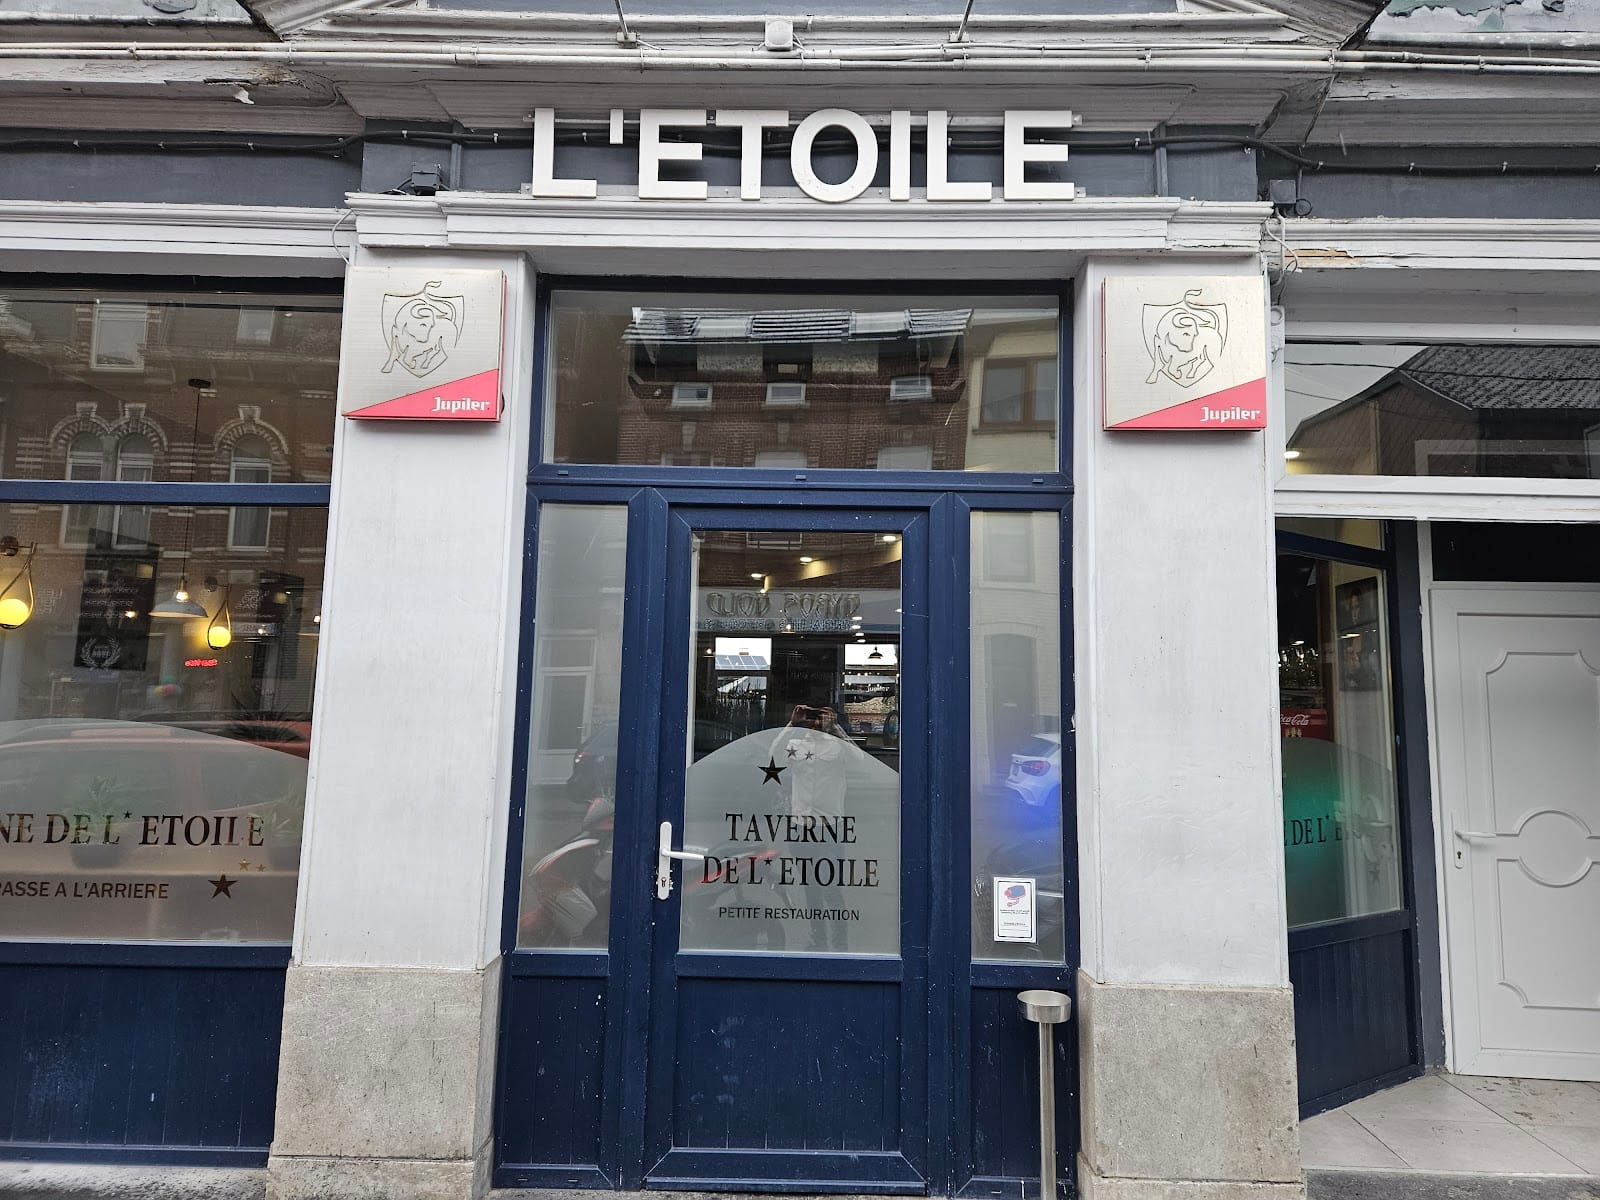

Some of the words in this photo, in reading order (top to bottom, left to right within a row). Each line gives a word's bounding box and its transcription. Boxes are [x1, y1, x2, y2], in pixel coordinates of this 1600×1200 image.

[531, 107, 1076, 203] L'ETOILE
[432, 396, 491, 413] Jupiler
[1200, 406, 1260, 423] Jupiler
[43, 814, 91, 845] DE
[725, 812, 857, 844] TAVERNE
[701, 856, 740, 884] DE
[0, 881, 50, 897] ASSE
[54, 882, 67, 897] A
[73, 882, 169, 899] L'ARRIERE
[719, 907, 761, 919] PETITE
[765, 908, 860, 921] RESTAURATION
